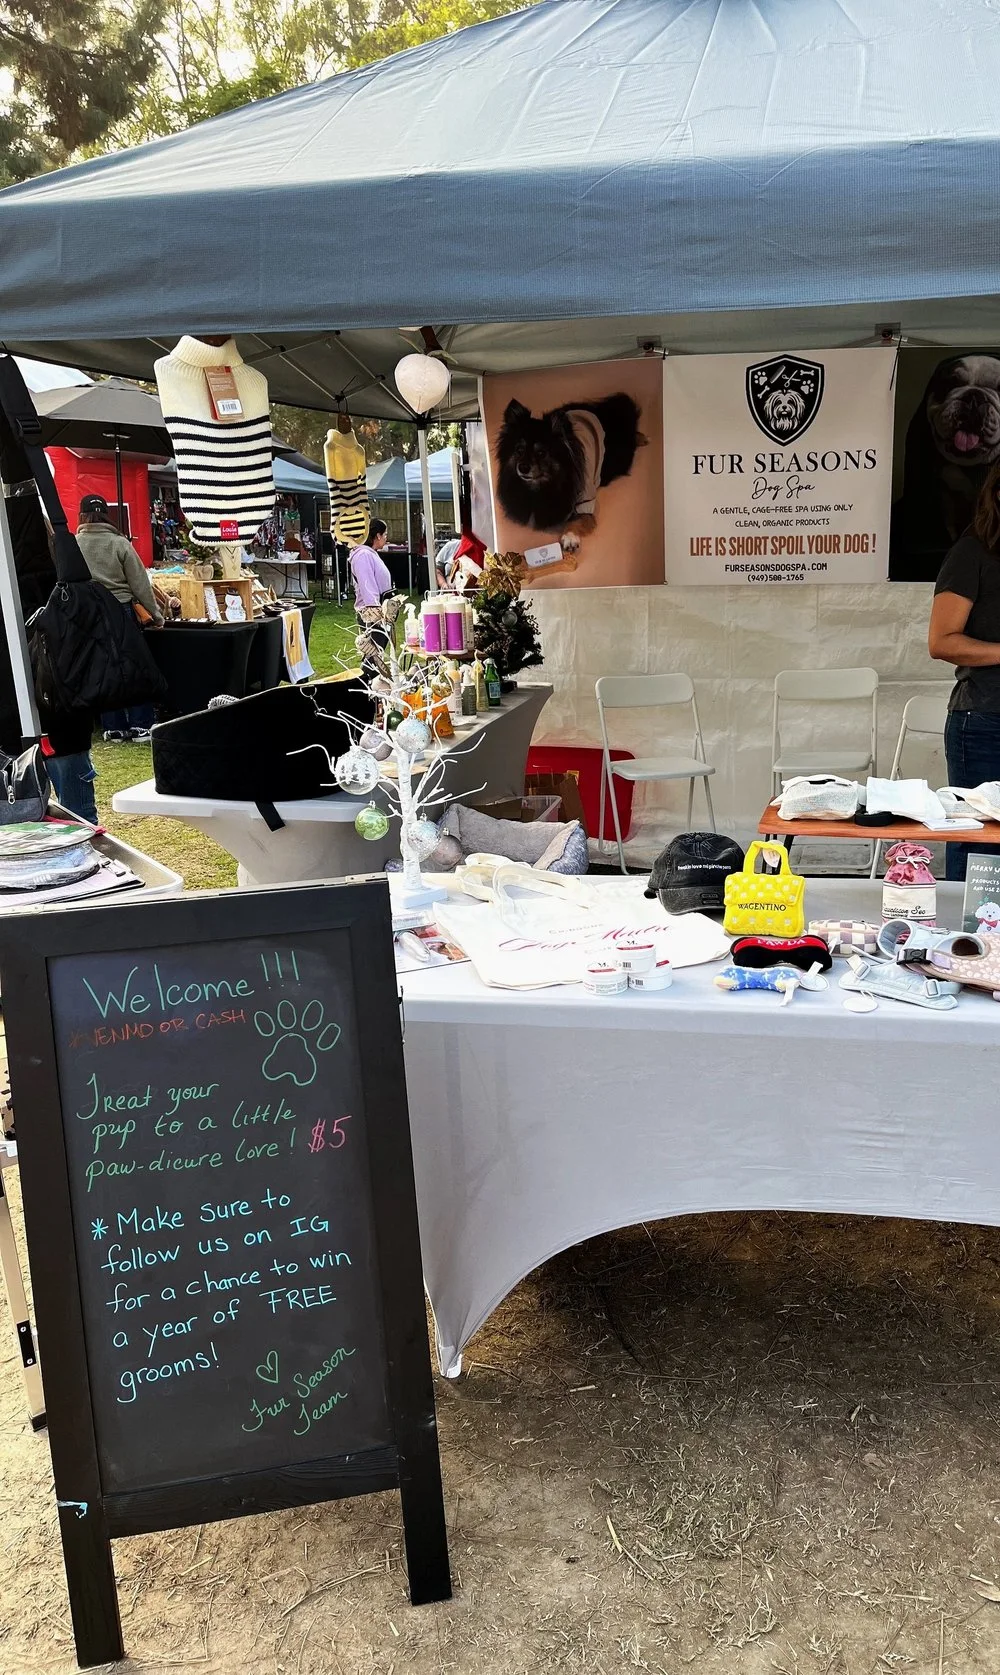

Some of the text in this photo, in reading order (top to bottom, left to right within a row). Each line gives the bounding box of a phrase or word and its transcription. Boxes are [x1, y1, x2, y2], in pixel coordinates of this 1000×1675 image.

[692, 449, 877, 475] FUR SEASONS
[720, 507, 750, 515] GENTLE,
[752, 505, 793, 513] CAGE-FREE
[795, 505, 809, 513] SPA
[834, 504, 853, 512] ONLY
[752, 475, 815, 500] Dog Spa
[735, 518, 830, 528] CLEAN, ORGANIC PRODUCTS
[690, 537, 712, 556] LIFE
[715, 537, 725, 556] IS
[728, 536, 769, 556] SHORT
[771, 535, 806, 555] SPOIL
[807, 535, 840, 554] YOUR
[725, 563, 827, 572] FURSEASONSDOGSPA.COM
[738, 903, 786, 911] WAGENTINO
[83, 964, 254, 1018] Welcome
[160, 1019, 186, 1033] OR
[195, 1009, 247, 1029] CASH
[165, 1083, 219, 1116] your
[92, 1098, 296, 1154] pup to a little
[85, 1150, 223, 1193] paw-dicure
[308, 1115, 352, 1153] $5
[116, 1206, 185, 1235] Make
[260, 1188, 290, 1210] to
[101, 1215, 329, 1274] follow us on IG
[106, 1250, 351, 1313] for a chance to win
[113, 1285, 337, 1358] a year of FREE
[116, 1341, 219, 1403] grooms!
[241, 1348, 356, 1432] Fur Season
[293, 1391, 348, 1435] Team
